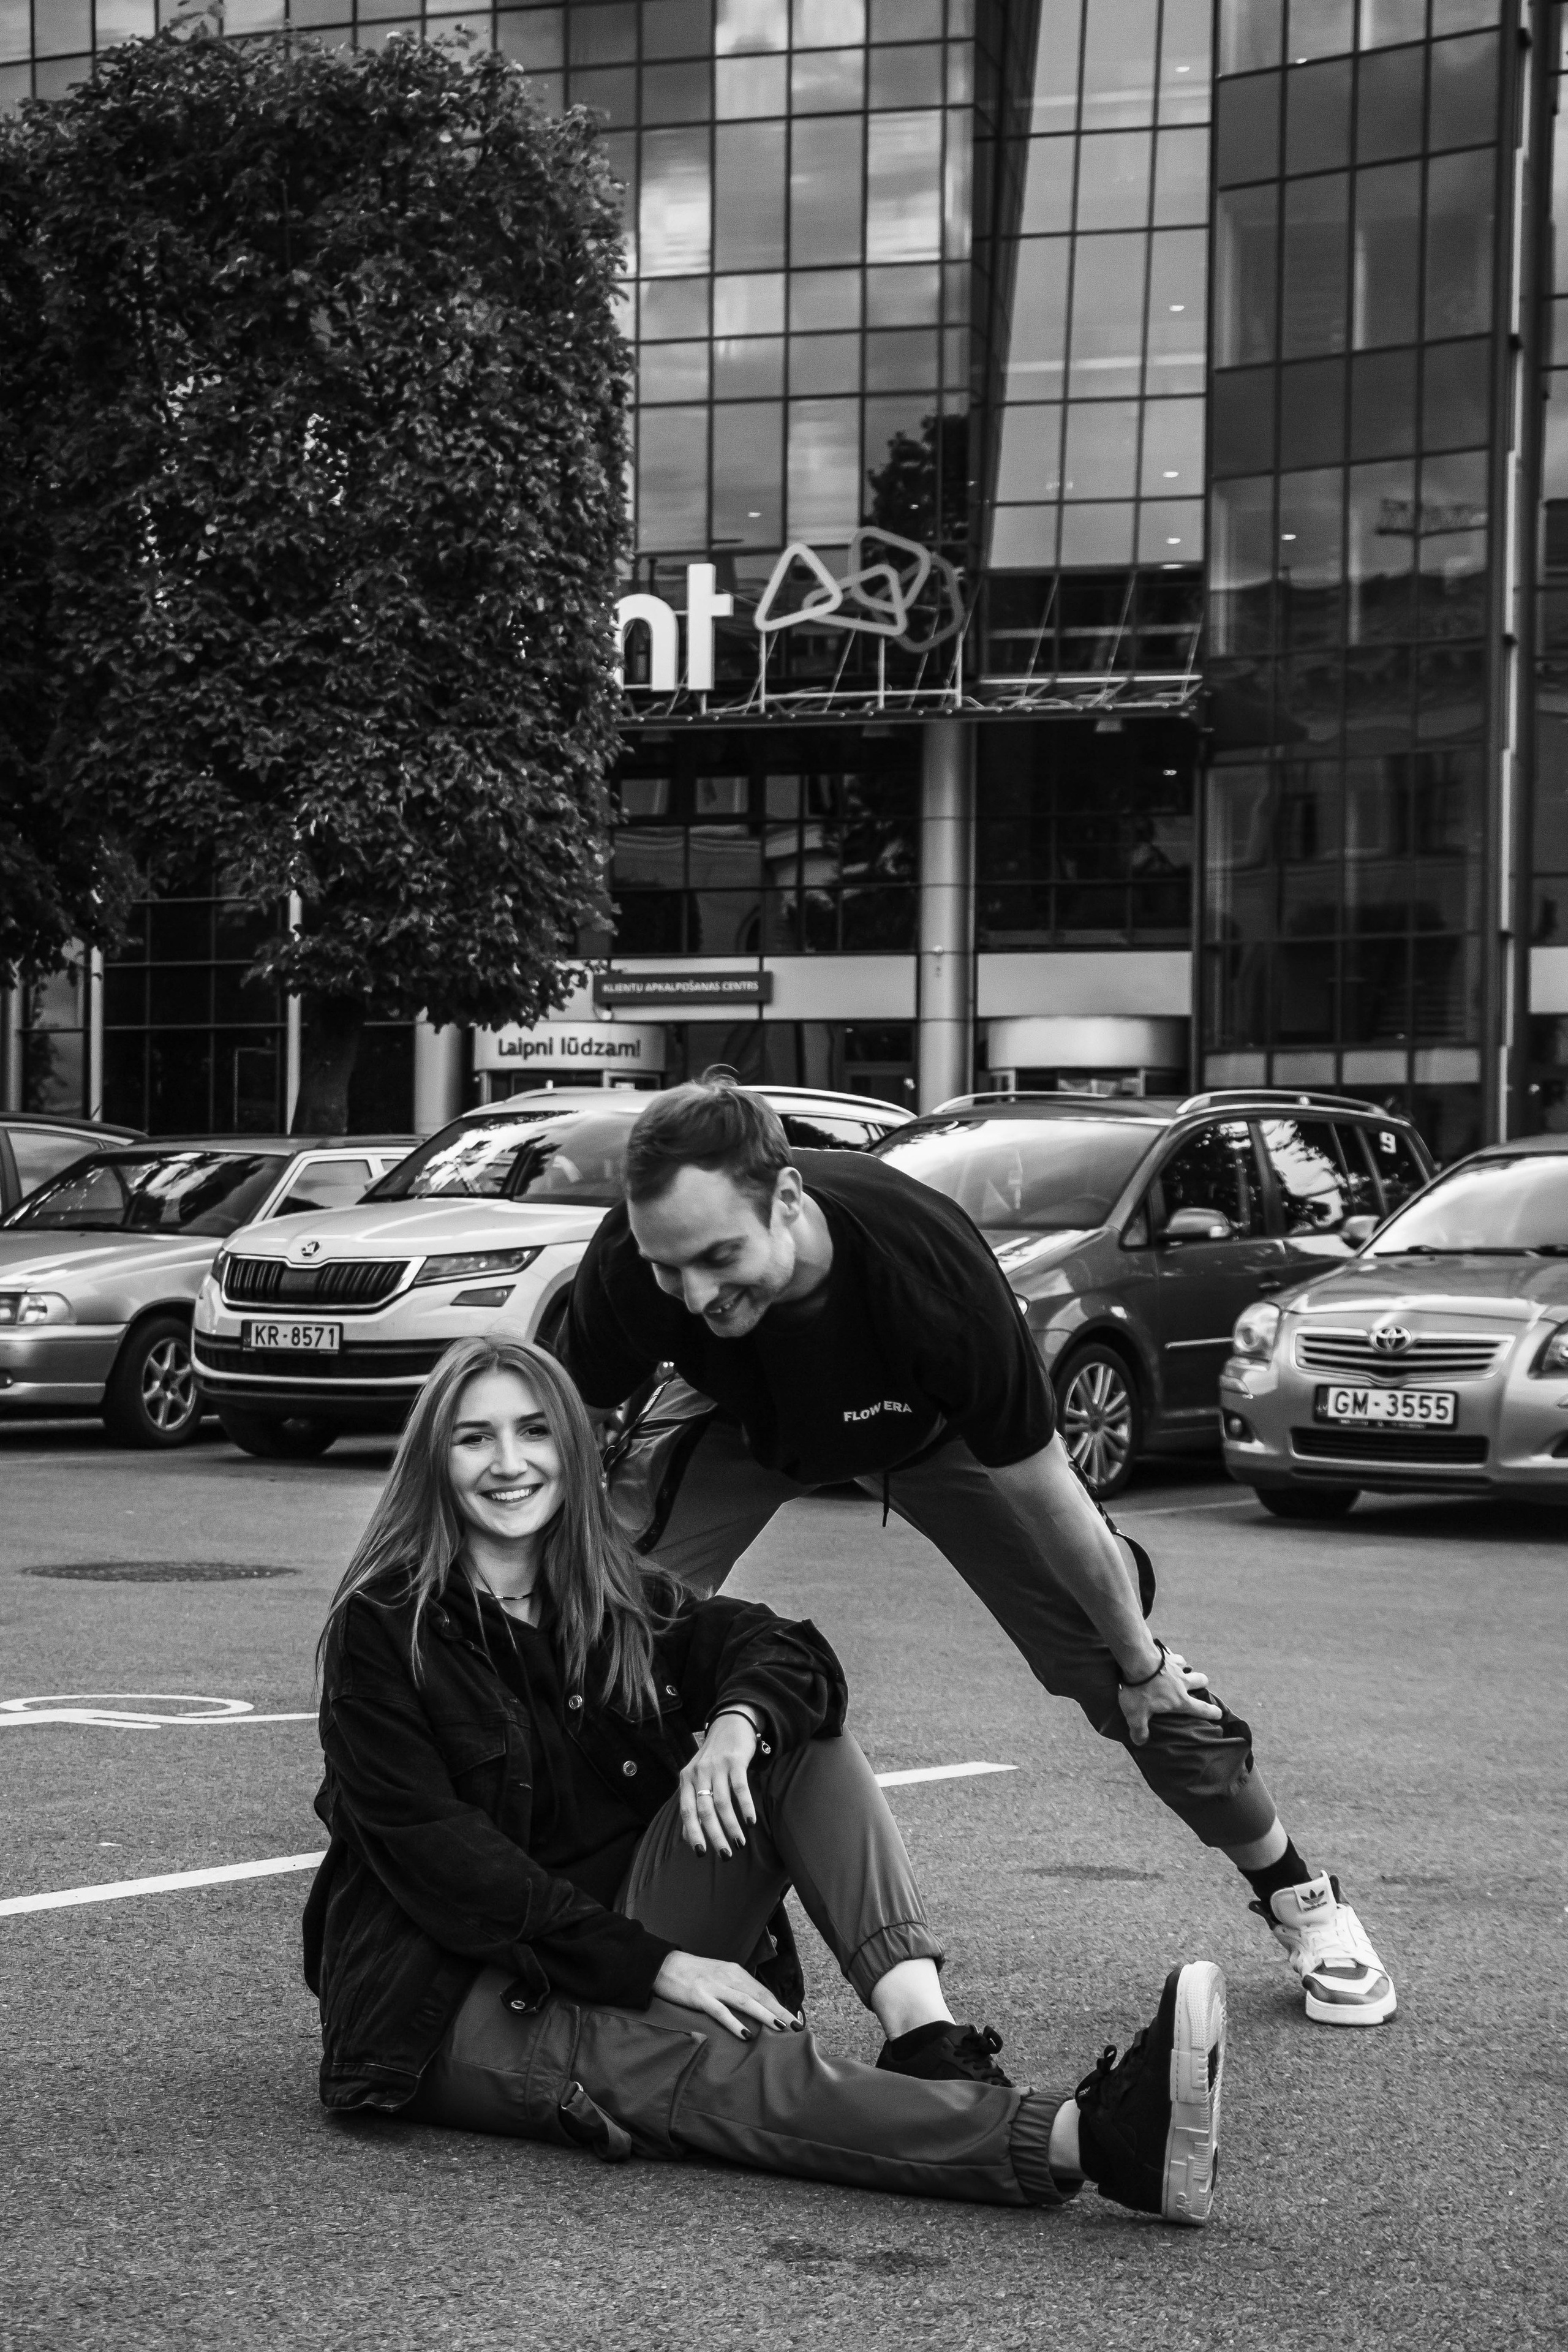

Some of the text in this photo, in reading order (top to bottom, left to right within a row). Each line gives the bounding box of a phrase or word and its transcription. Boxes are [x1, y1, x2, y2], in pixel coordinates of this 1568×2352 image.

[499, 1037, 553, 1060] Laipni
[1379, 1131, 1396, 1153] 9
[255, 1325, 334, 1348] KR-8571
[843, 1400, 912, 1422] FLOW ERA
[1335, 1391, 1449, 1420] GM-3555
